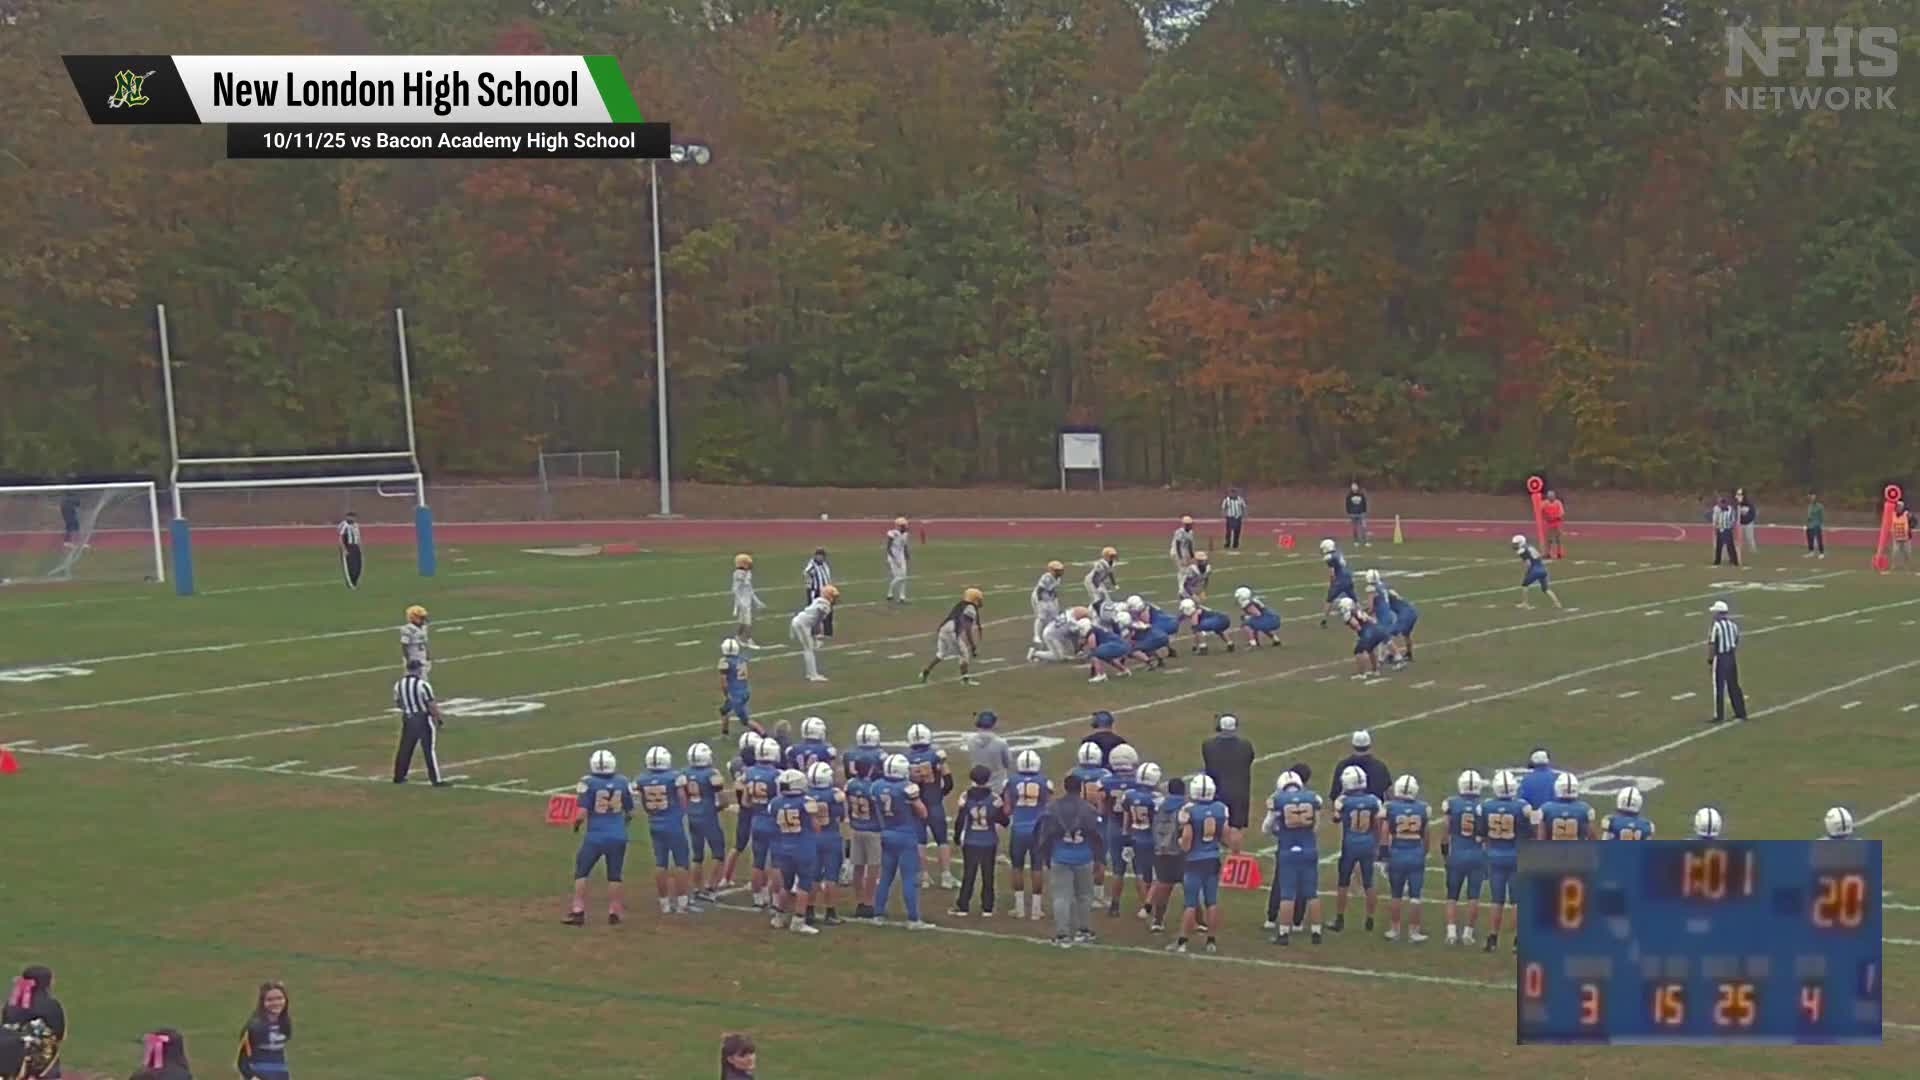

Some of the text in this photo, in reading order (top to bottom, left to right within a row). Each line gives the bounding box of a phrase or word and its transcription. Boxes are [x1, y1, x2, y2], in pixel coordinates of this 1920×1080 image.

[550, 797, 575, 819] 20
[1225, 859, 1249, 885] 30
[1560, 877, 1584, 928] 8
[1813, 875, 1865, 928] 20
[1581, 984, 1599, 1024] 3
[1655, 984, 1683, 1024] 15
[1715, 984, 1755, 1025] 25
[1801, 987, 1822, 1021] 4
